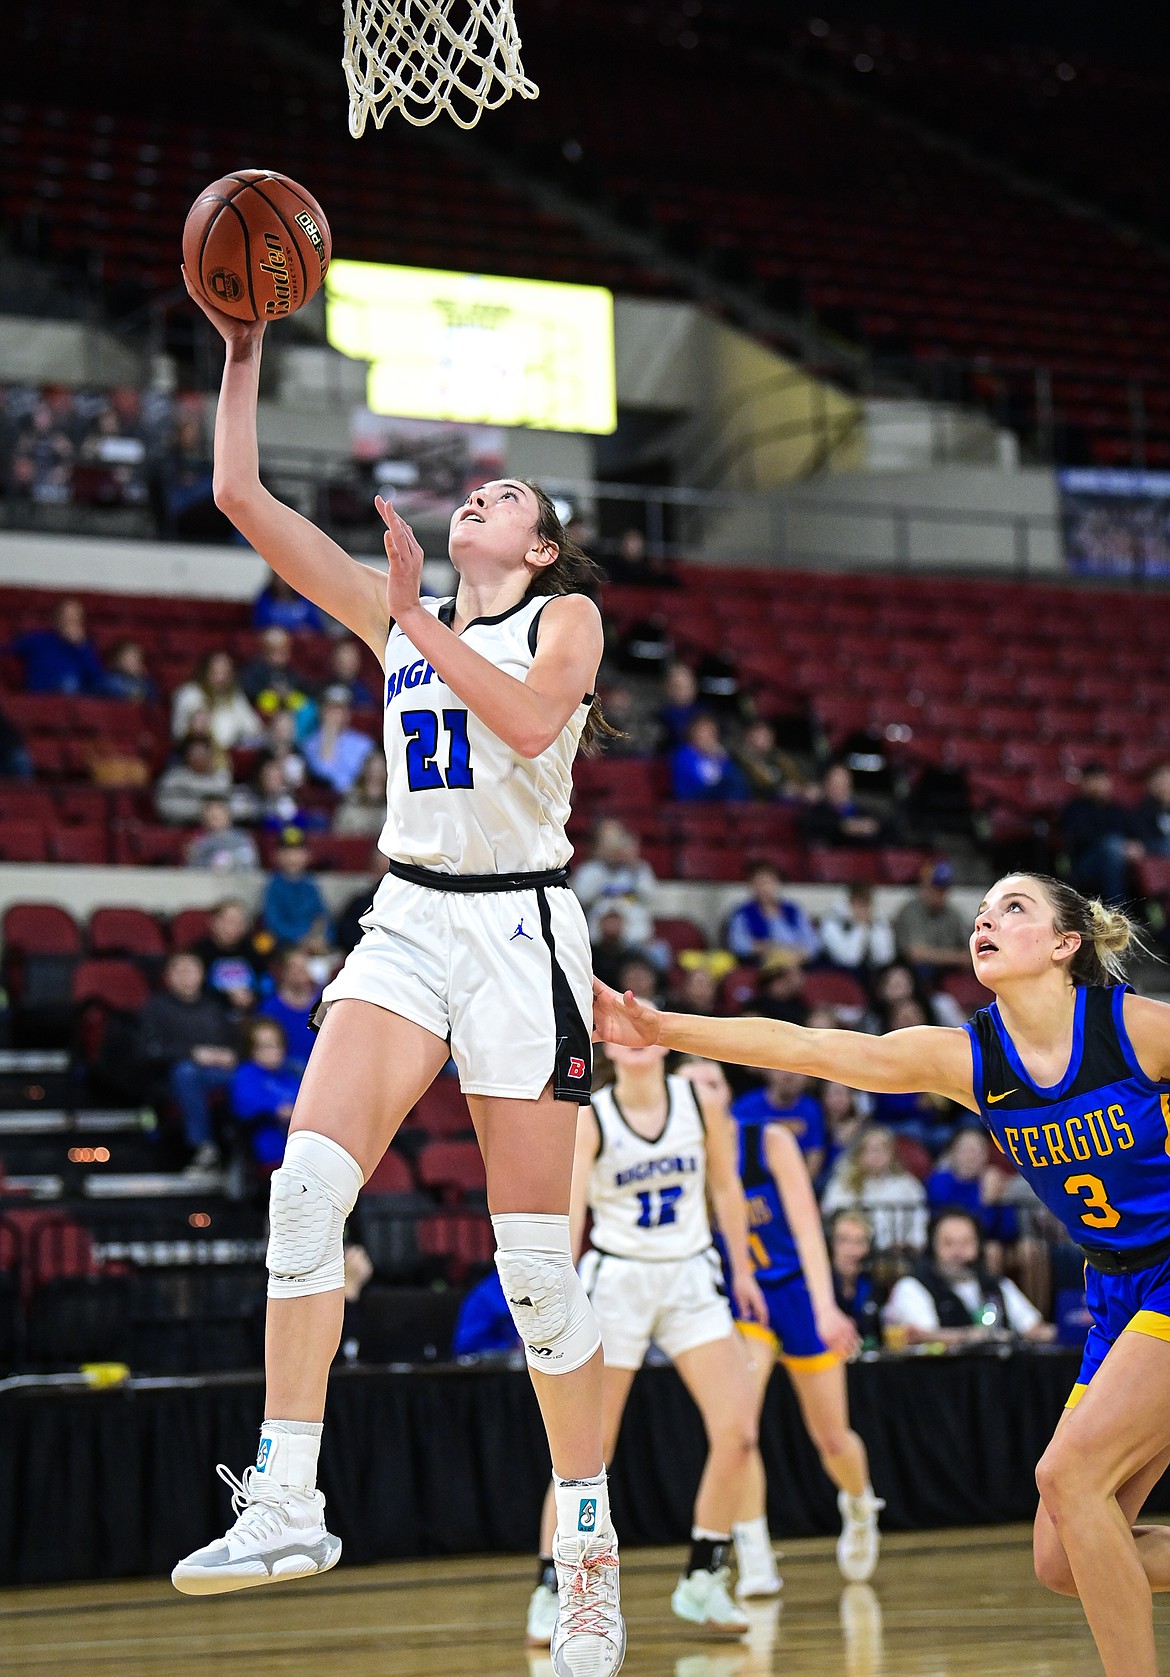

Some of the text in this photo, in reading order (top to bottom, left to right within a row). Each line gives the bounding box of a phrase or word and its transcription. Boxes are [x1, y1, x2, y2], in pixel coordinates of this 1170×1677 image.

[298, 213, 321, 245] PRO
[260, 232, 291, 315] Baden
[386, 658, 447, 710] BIGF
[400, 708, 474, 793] 21
[567, 1056, 586, 1079] B
[1004, 1103, 1135, 1167] FERGUS
[1063, 1173, 1121, 1229] 3
